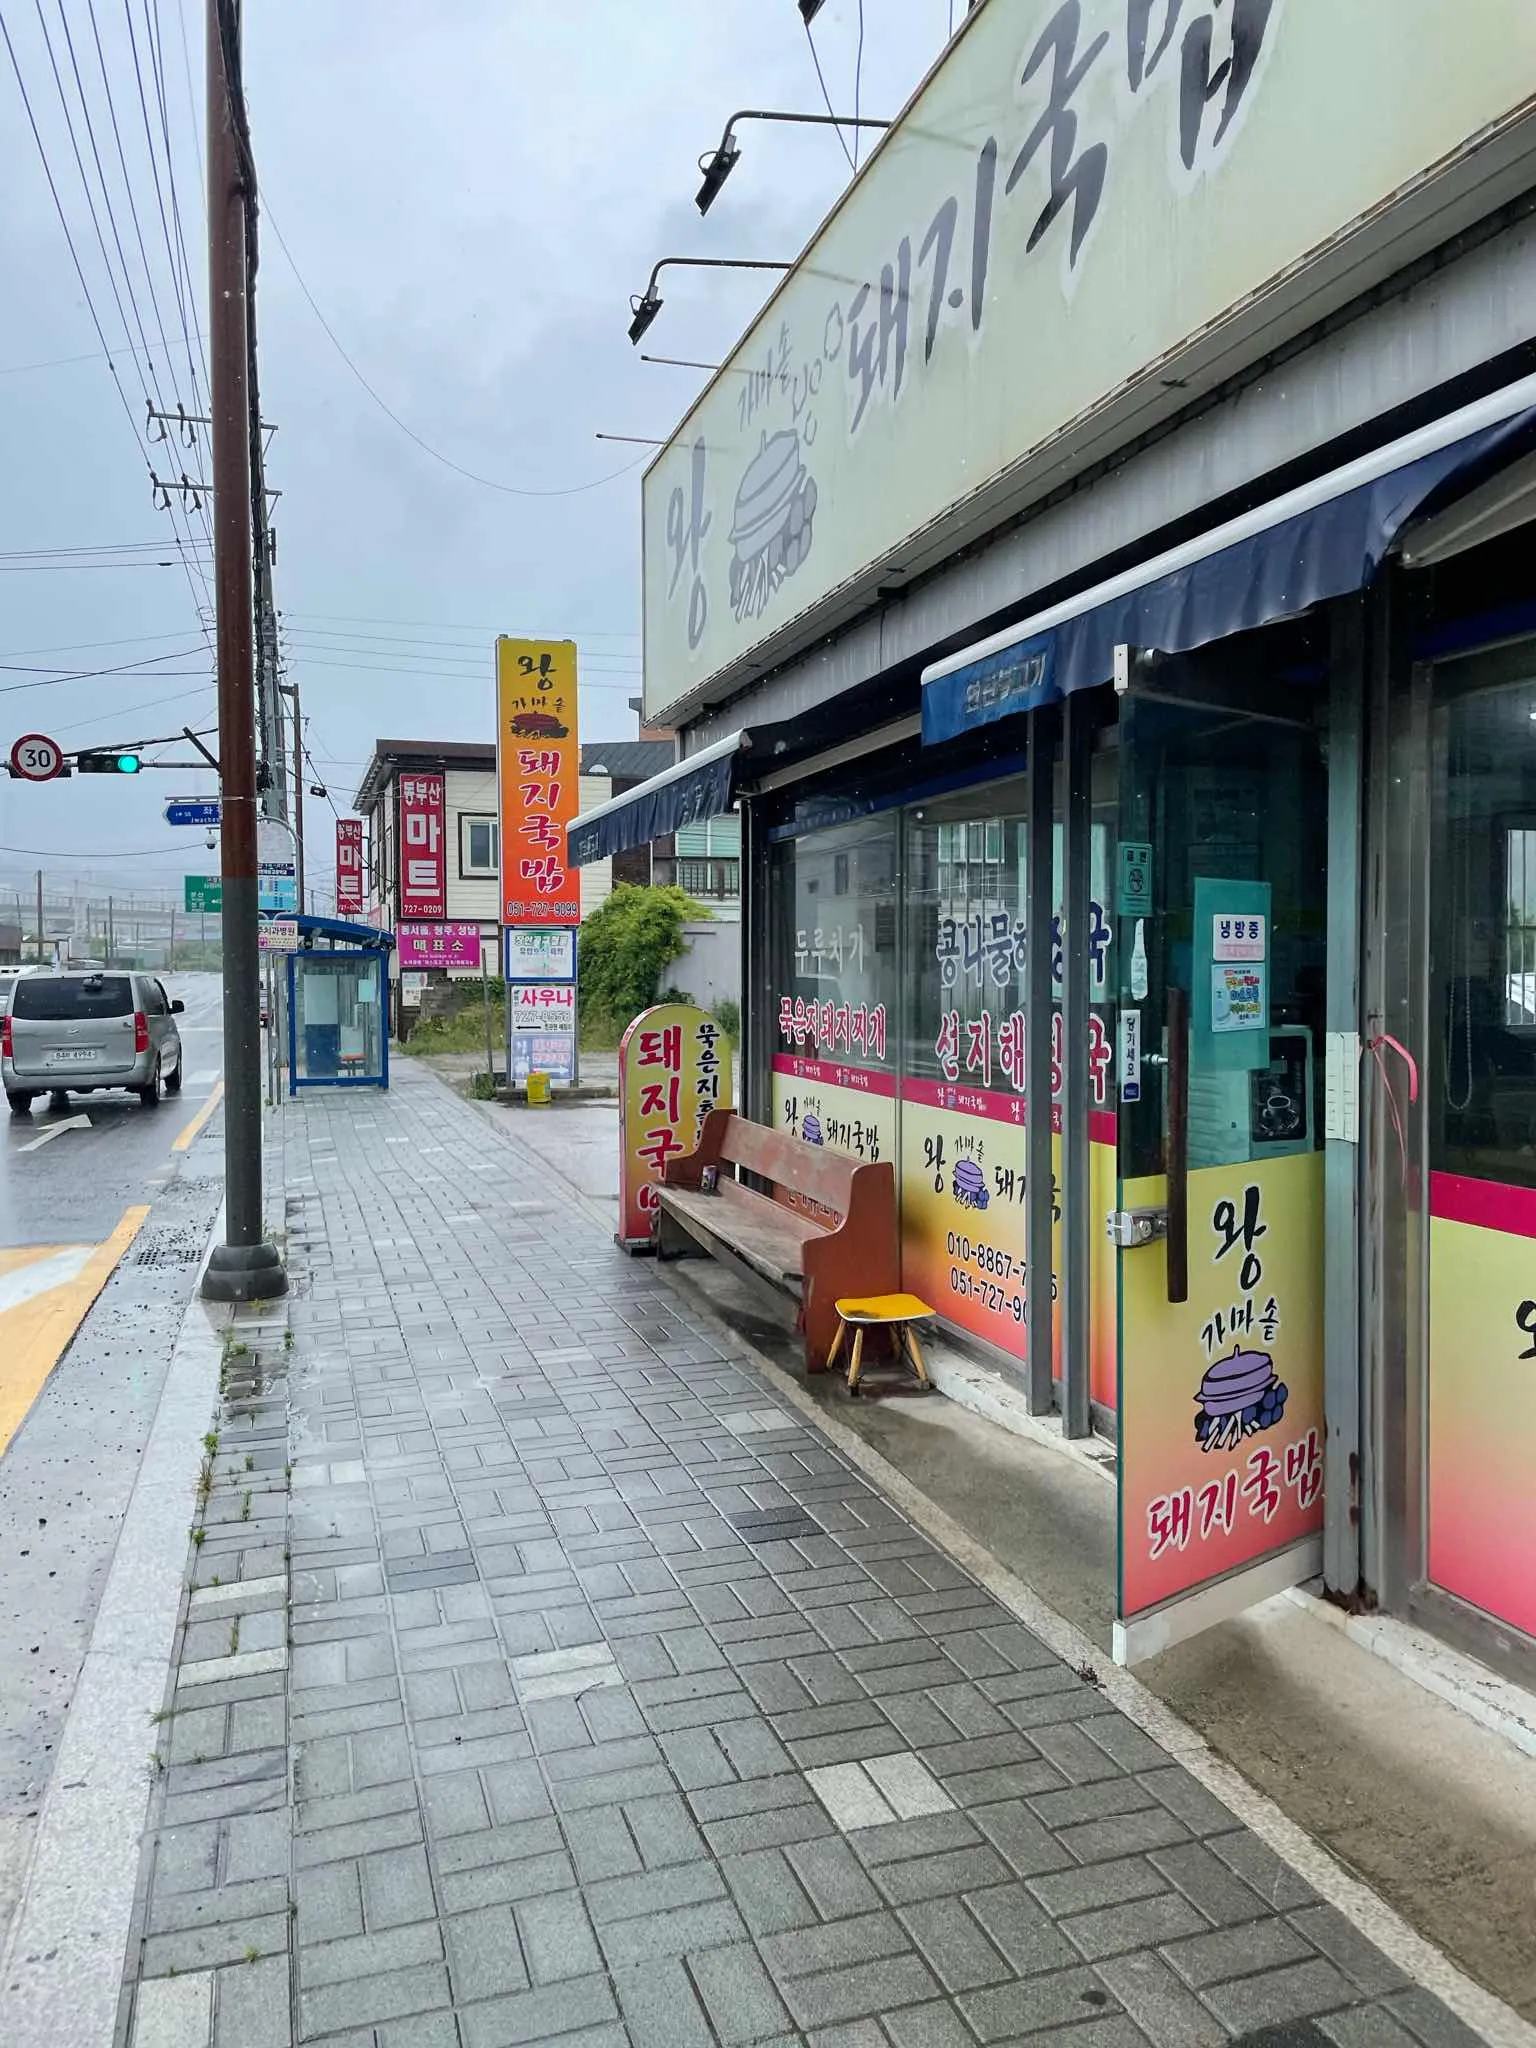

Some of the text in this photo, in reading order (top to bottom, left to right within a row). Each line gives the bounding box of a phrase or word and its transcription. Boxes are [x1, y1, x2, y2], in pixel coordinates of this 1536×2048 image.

[666, 435, 712, 651] 왕
[848, 0, 1272, 436] 돼지국밥
[517, 653, 557, 690] 왕
[512, 696, 567, 714] 가마솥
[24, 748, 50, 768] 30
[403, 780, 440, 806] 동부산
[519, 750, 564, 894] 돼지국밥
[339, 845, 361, 900] 마트
[405, 813, 441, 897] 마트
[403, 904, 442, 913] 727-0209
[506, 902, 578, 917] 051-727-9099
[1220, 920, 1259, 939] 냉방중
[794, 922, 864, 974] 두루치기
[936, 901, 1112, 987] 콩나물국
[521, 989, 573, 1007] 사우나
[779, 996, 887, 1060] 묵은지돼지찌개
[637, 1026, 684, 1210] 돼지국
[827, 1117, 880, 1163] 돼지국밥
[924, 1135, 946, 1194] 왕
[954, 1136, 985, 1163] 가마솥
[1213, 1185, 1267, 1291] 왕
[1202, 1297, 1280, 1354] 가마솥
[1149, 1430, 1323, 1558] 돼지국밥
